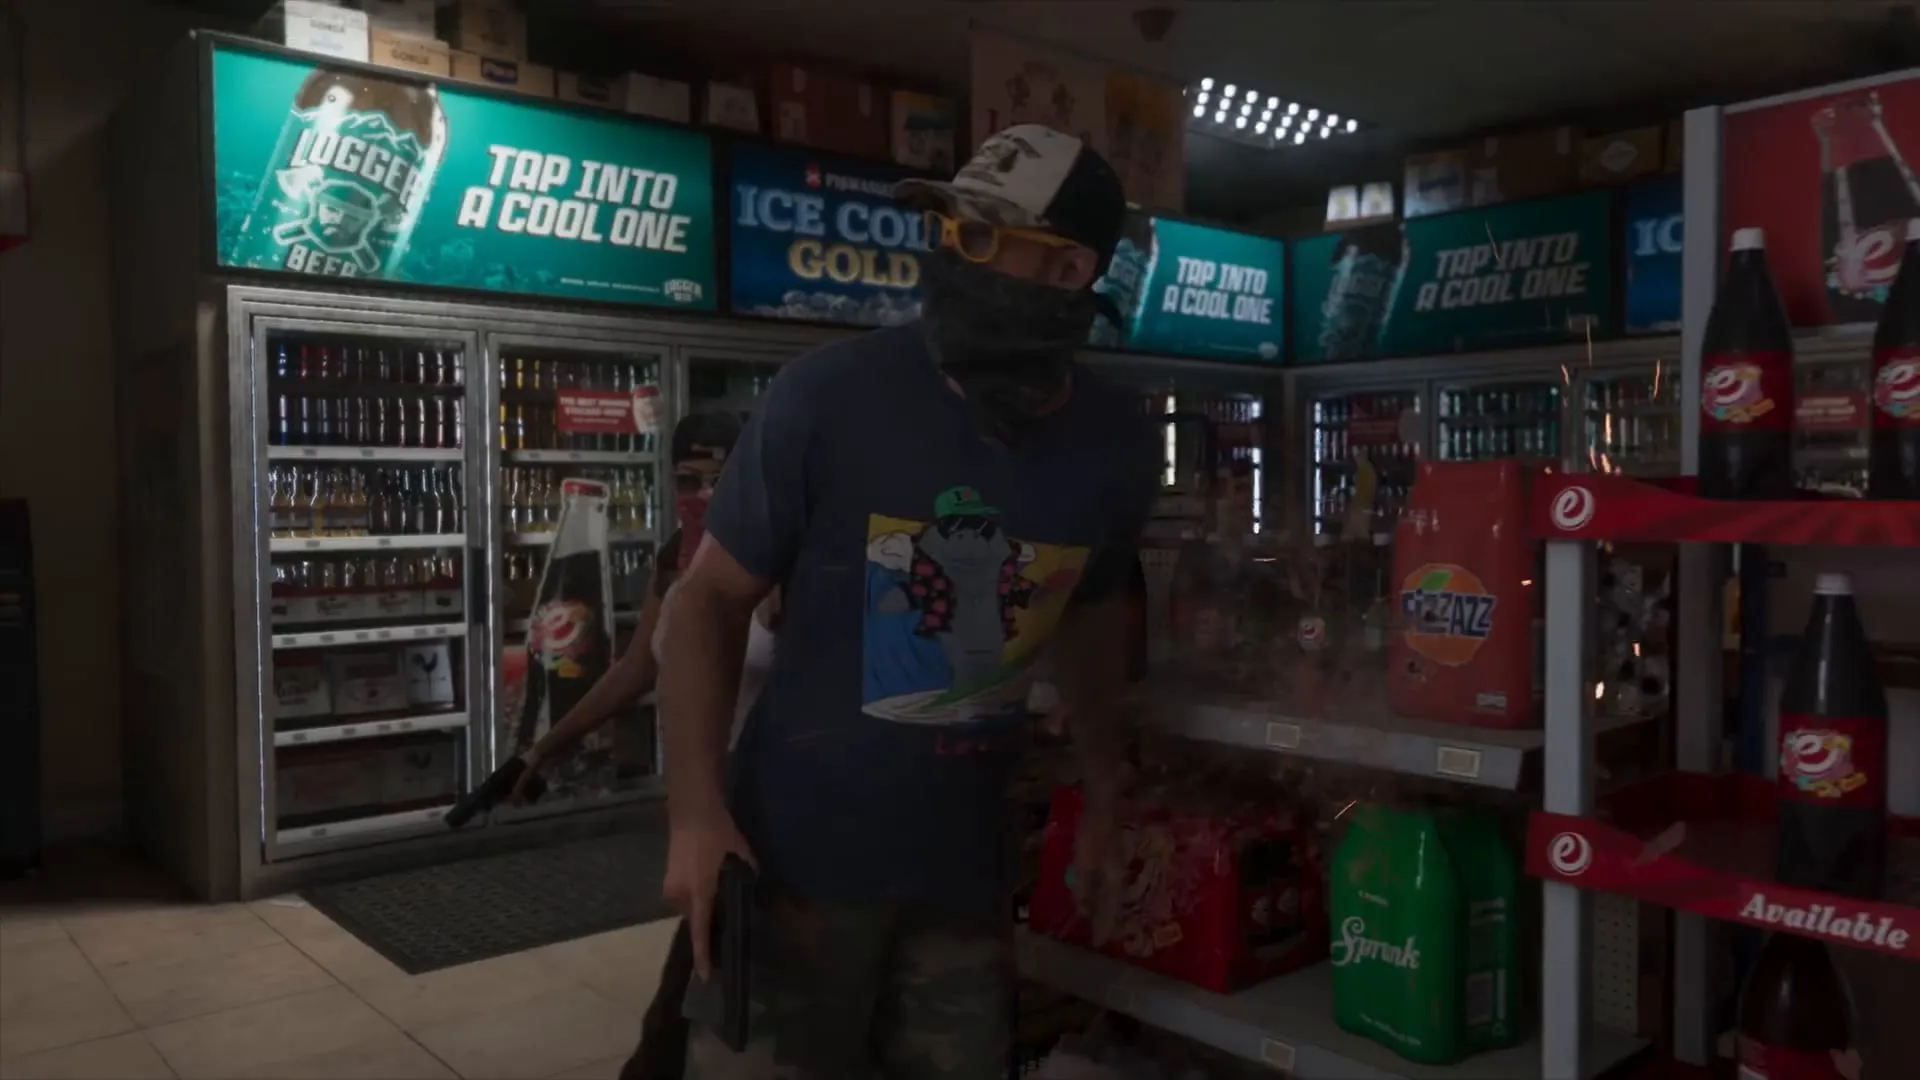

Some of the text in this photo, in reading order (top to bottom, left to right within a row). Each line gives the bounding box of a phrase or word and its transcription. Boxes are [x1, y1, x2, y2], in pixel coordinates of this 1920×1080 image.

[290, 127, 423, 213] LOGGER
[488, 144, 679, 210] TAP INTO
[456, 185, 692, 255] A COOL ONE
[735, 184, 933, 252] ICE COL
[787, 238, 920, 290] GOLD
[1177, 255, 1217, 288] TAP
[1217, 262, 1268, 296] INTO
[1436, 232, 1579, 280] TAP INTO
[1161, 284, 1275, 326] A COOL ONE
[1413, 281, 1440, 313] A
[1441, 270, 1515, 310] COOL
[1519, 260, 1593, 300] ONE
[1329, 915, 1421, 970] Sprunk
[1739, 892, 1911, 950] Available
